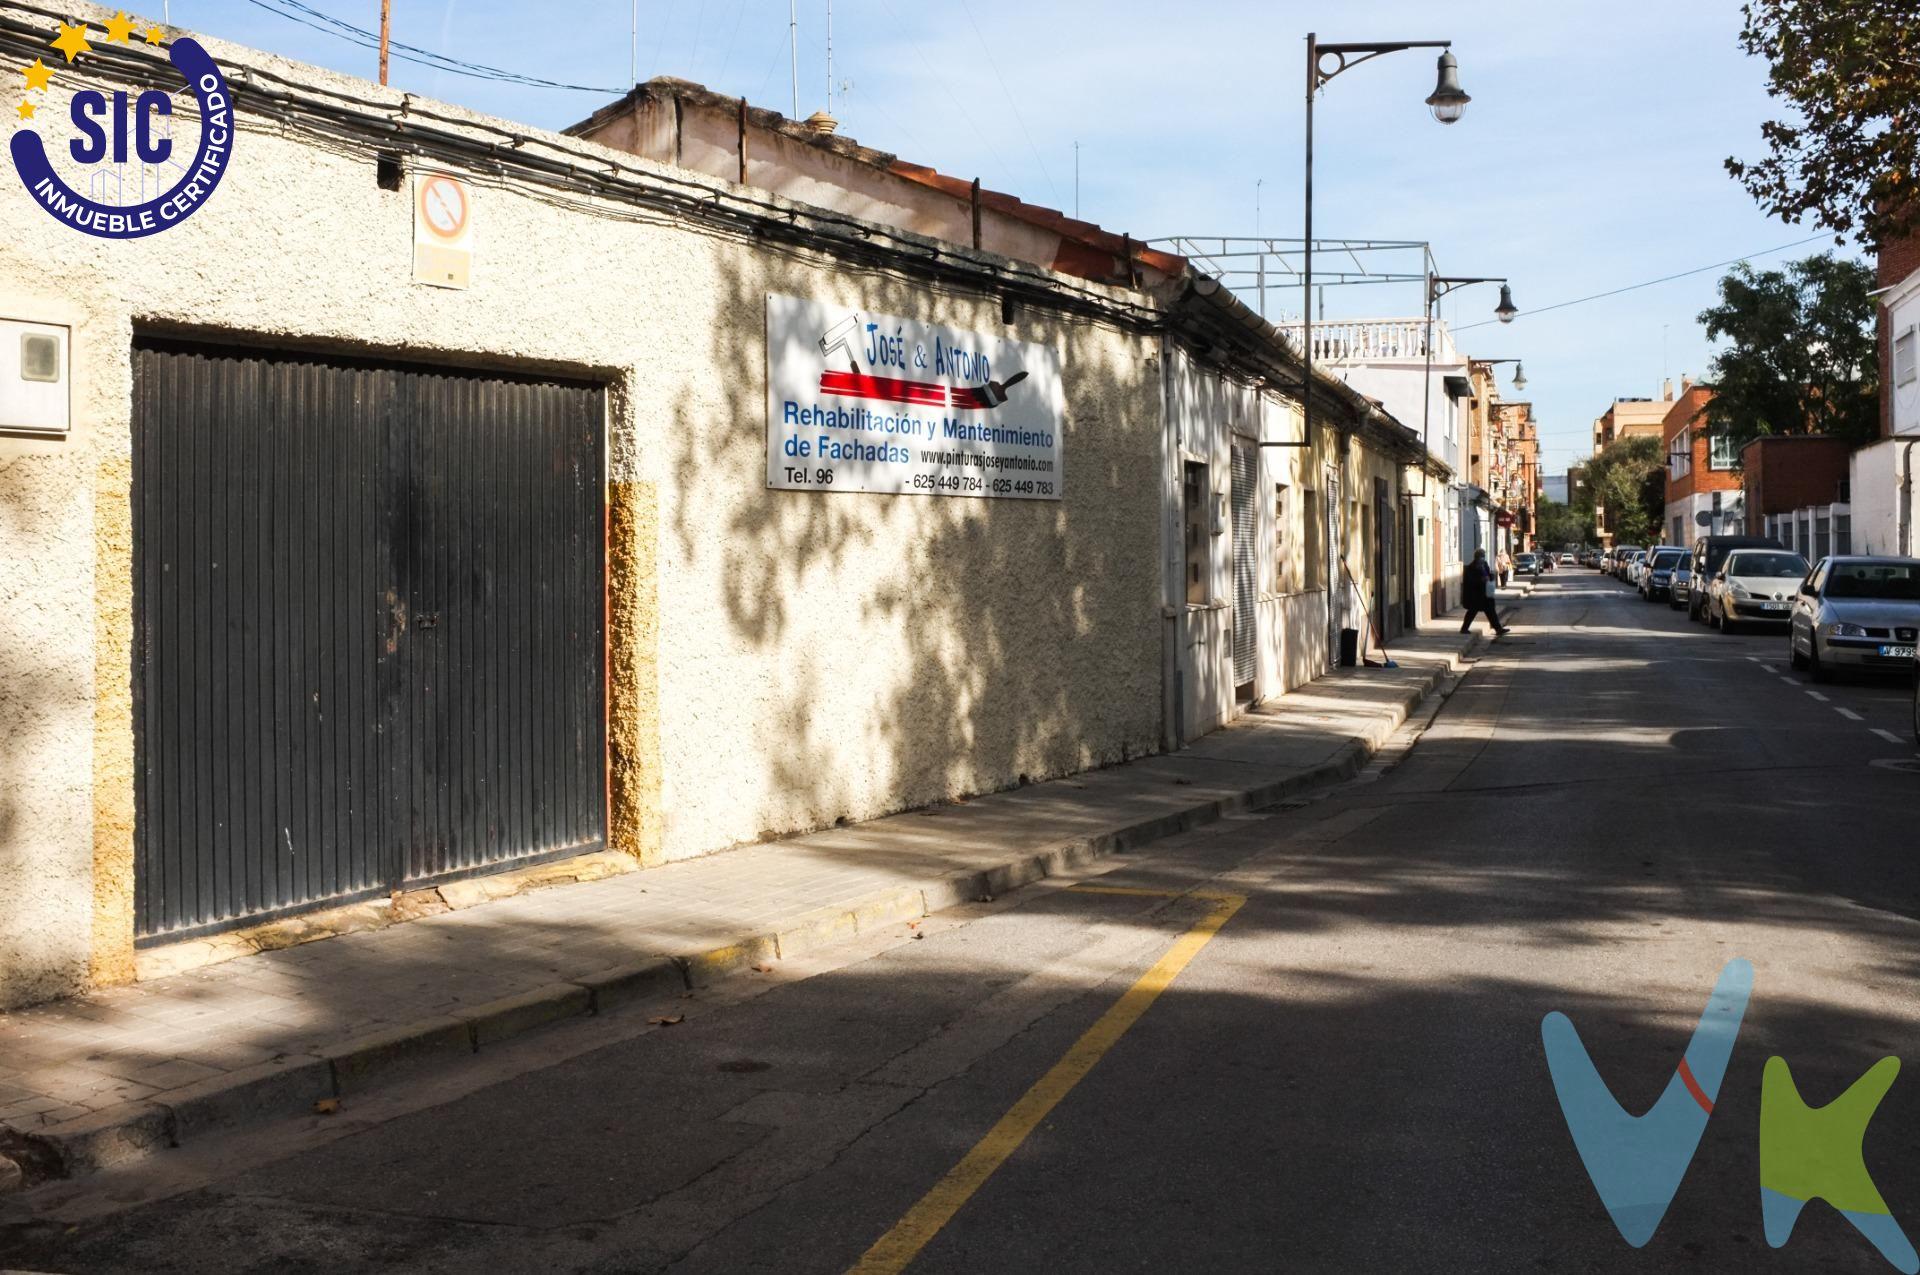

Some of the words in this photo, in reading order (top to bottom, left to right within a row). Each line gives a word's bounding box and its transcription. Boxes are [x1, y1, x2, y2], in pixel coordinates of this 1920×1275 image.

[915, 344, 928, 369] &
[936, 335, 990, 383] ANTONIO
[783, 400, 922, 435] Rehabilitación
[927, 420, 936, 441] y
[943, 417, 1054, 448] Mantenimiento
[784, 433, 811, 458] de
[818, 435, 909, 463] Fachadas
[920, 448, 1054, 473] www.pinturasjoseyantonio.com
[784, 466, 812, 484] Tel.
[816, 468, 834, 484] 96
[913, 474, 935, 489] 625
[937, 476, 960, 490] 449
[963, 477, 983, 491] 784
[992, 478, 1012, 493] 625
[1014, 480, 1034, 495] 449
[1036, 481, 1054, 495] 783
